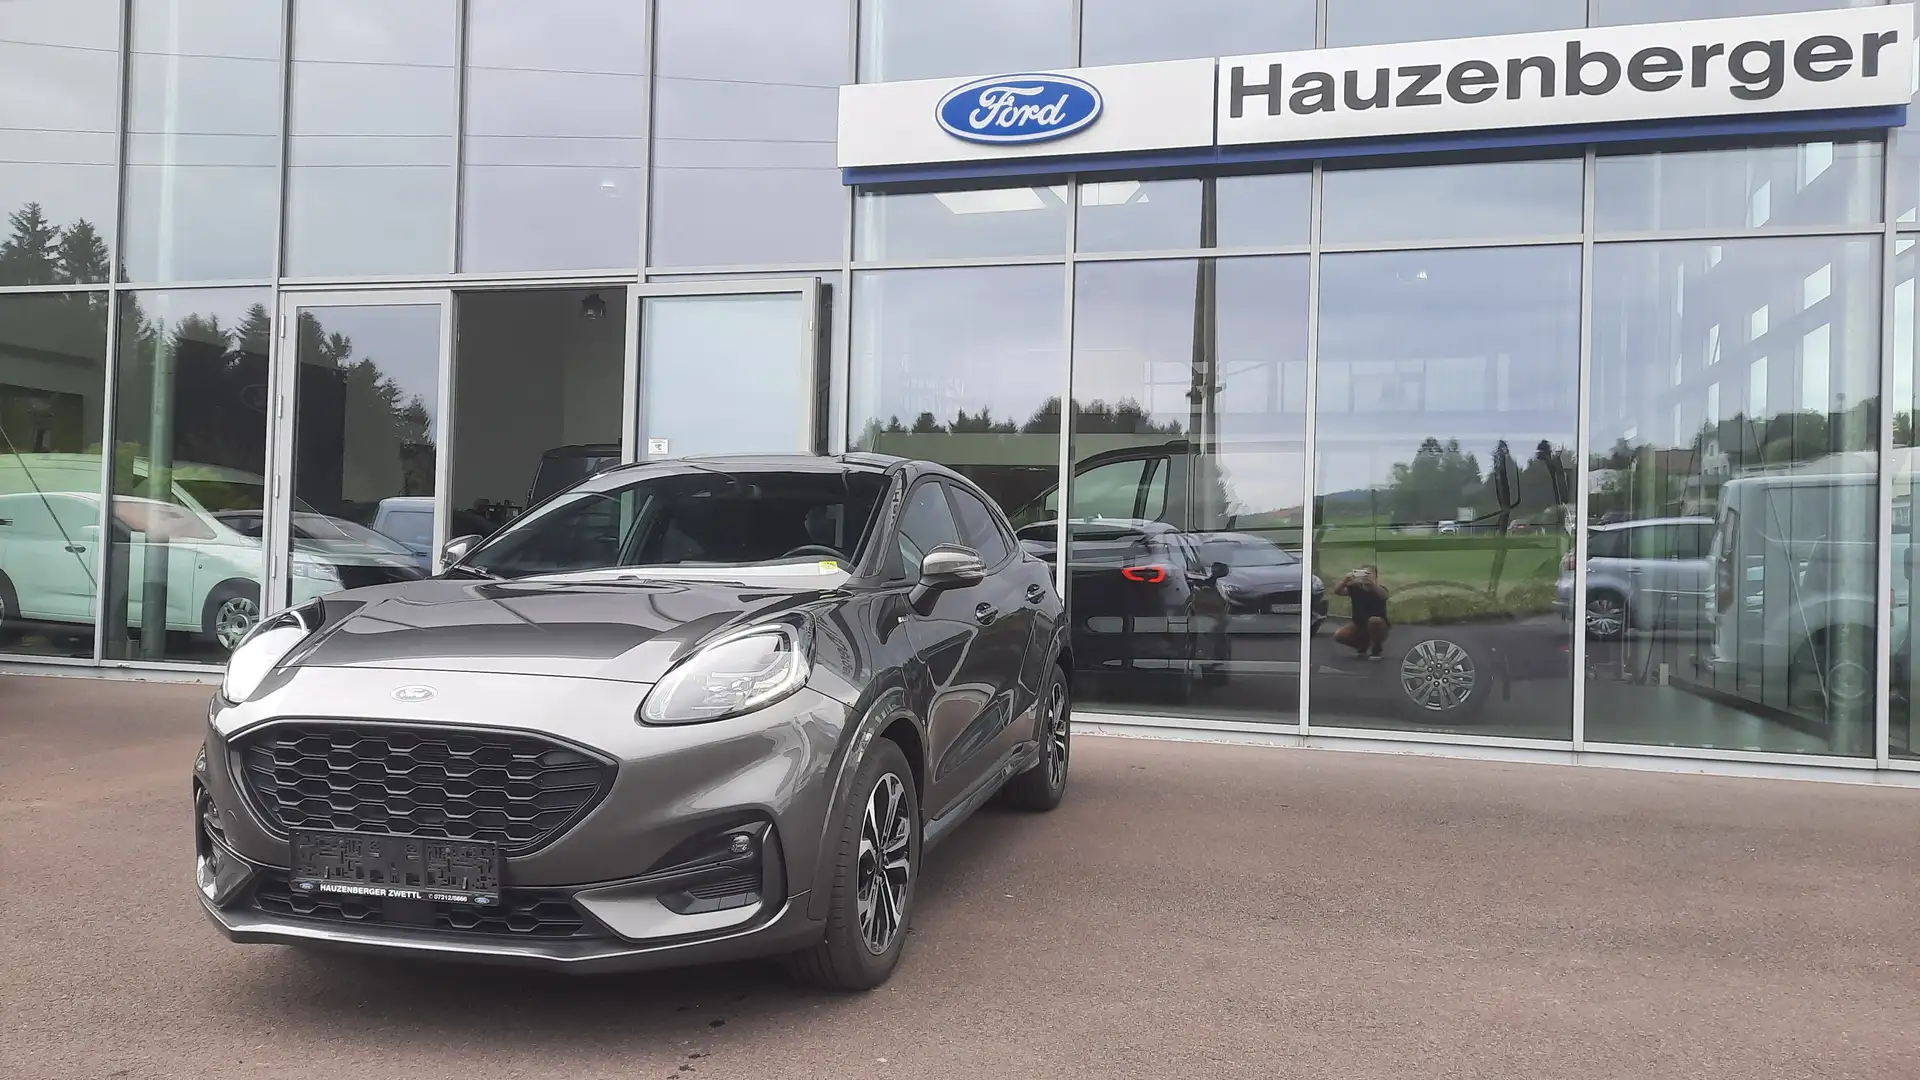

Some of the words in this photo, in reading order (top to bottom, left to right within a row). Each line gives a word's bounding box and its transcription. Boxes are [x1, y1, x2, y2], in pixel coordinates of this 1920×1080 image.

[1230, 31, 1898, 119] Hauzenberger
[969, 86, 1070, 130] Ford
[320, 884, 387, 896] HAUZENBERGER
[388, 889, 422, 899] ZWETTL
